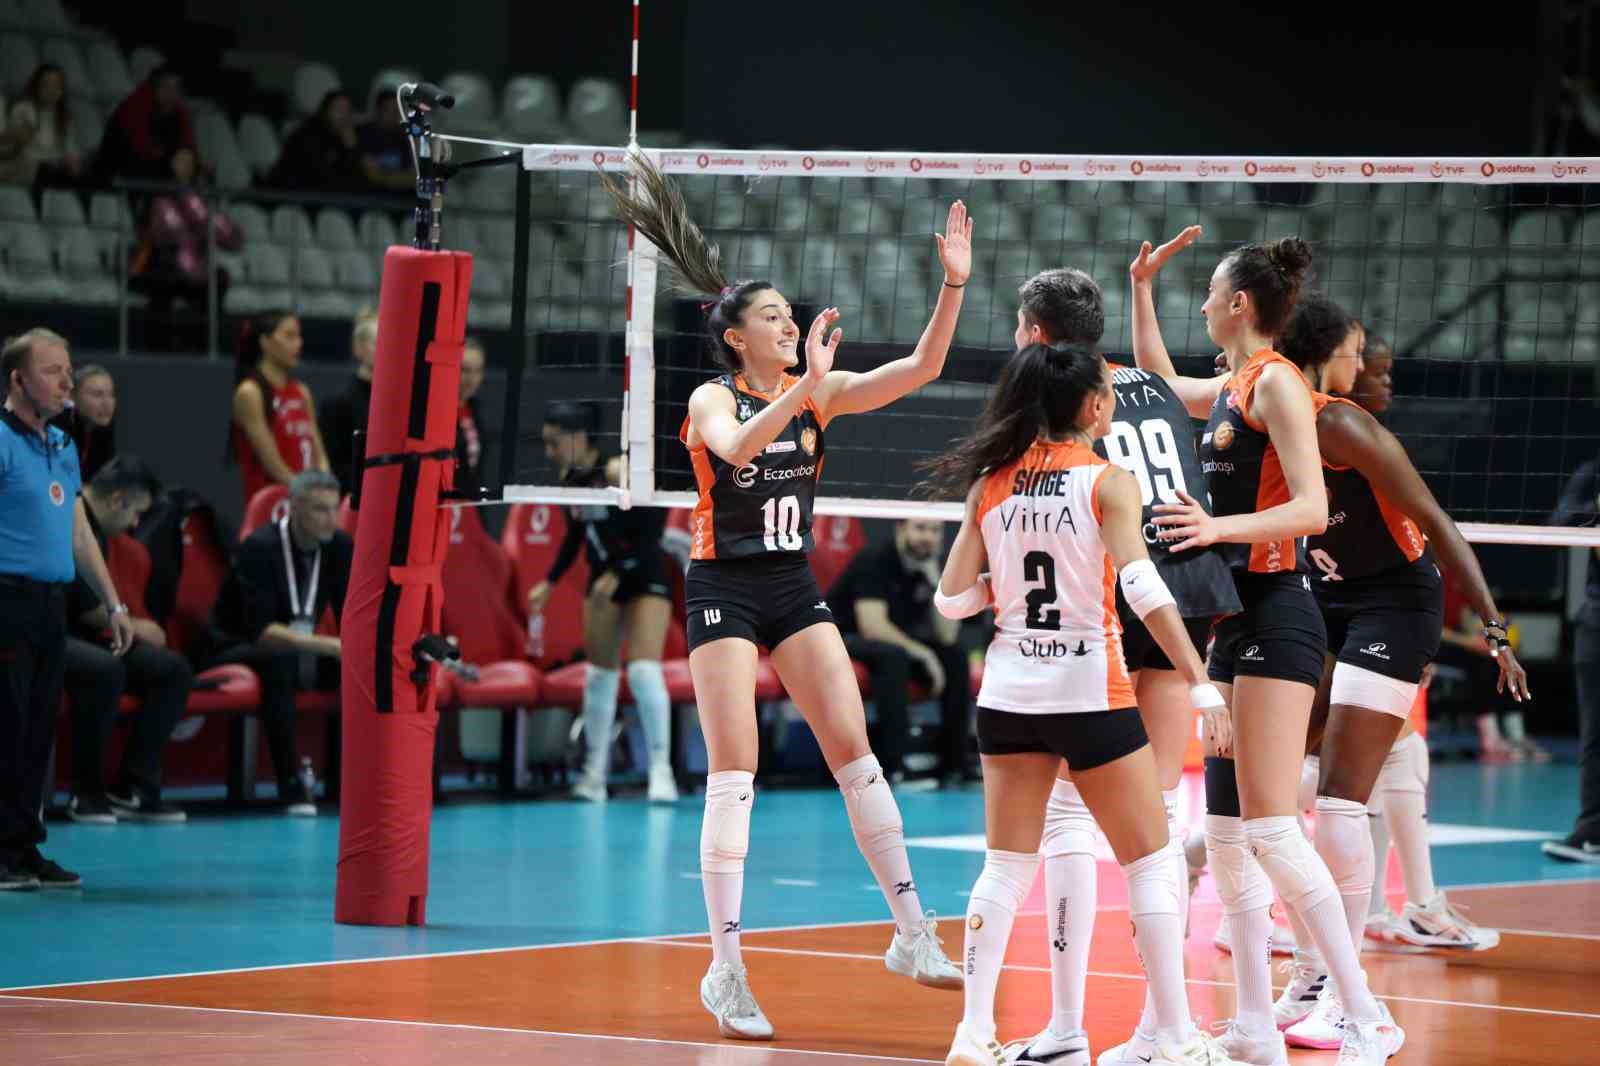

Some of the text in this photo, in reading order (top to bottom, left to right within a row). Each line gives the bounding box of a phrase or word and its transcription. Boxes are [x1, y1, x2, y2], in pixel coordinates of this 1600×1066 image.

[1376, 165, 1414, 173] vodafone
[1445, 166, 1465, 174] TVF
[1496, 165, 1536, 173] vodafone
[1567, 166, 1589, 175] TVF
[1103, 418, 1188, 506] 99
[761, 495, 803, 551] 10
[1023, 550, 1061, 632] 2
[1019, 638, 1068, 659] Club
